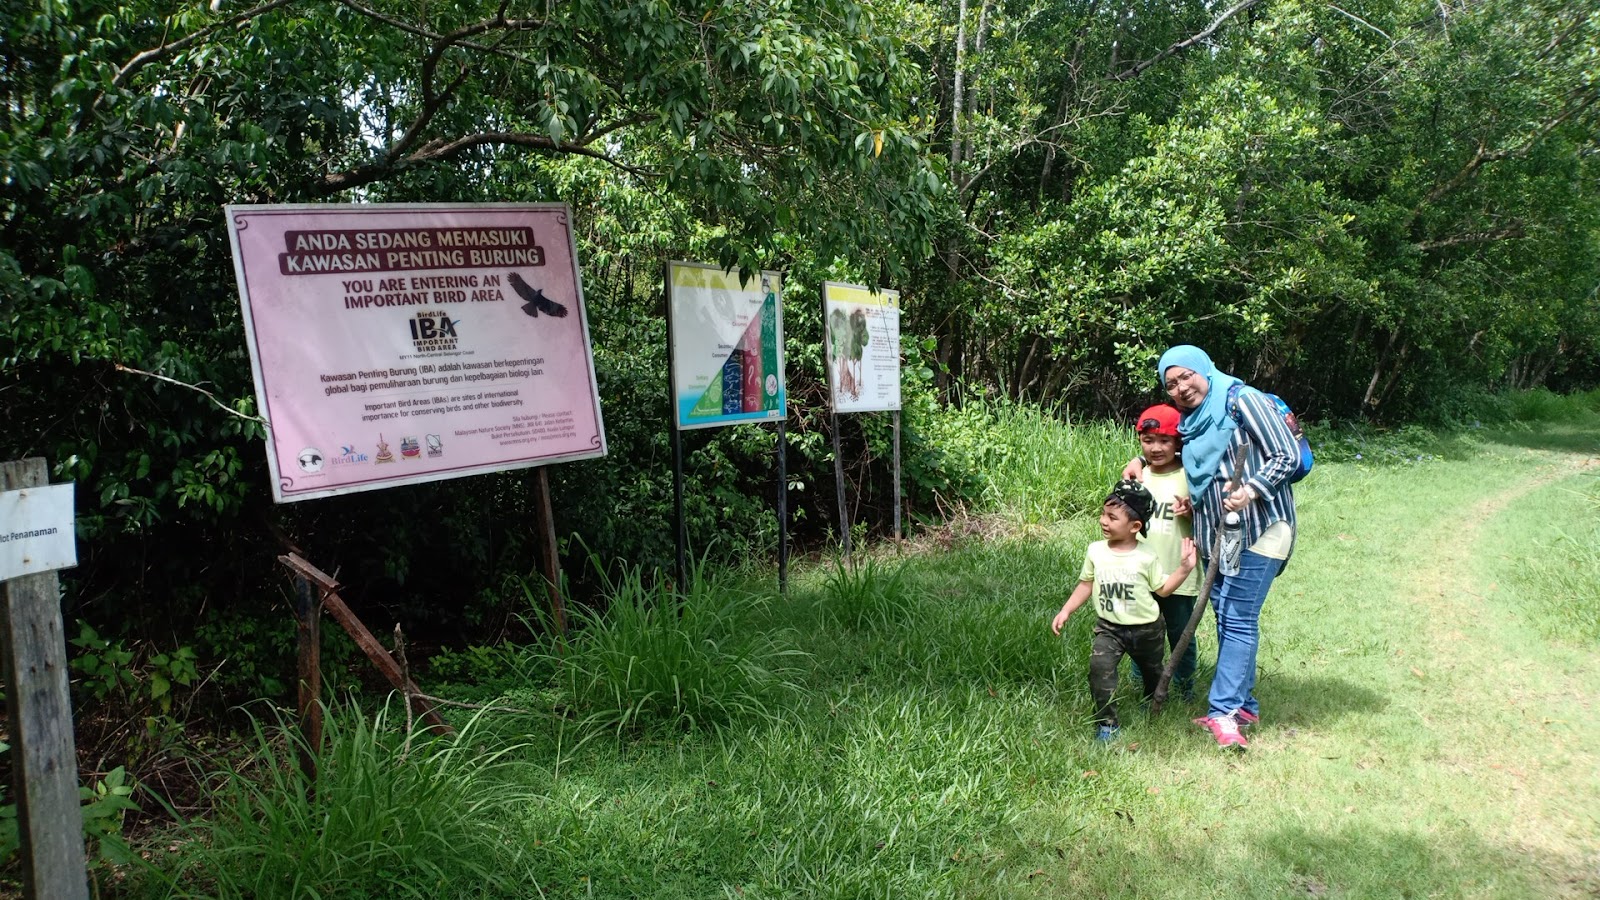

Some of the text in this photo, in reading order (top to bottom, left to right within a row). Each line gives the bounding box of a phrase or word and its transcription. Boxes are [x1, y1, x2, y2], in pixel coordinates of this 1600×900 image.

[295, 230, 528, 251] ANDA SEDANG MEMASUKI
[286, 248, 540, 273] KAWASAN PENTING BURUNG
[342, 274, 501, 294] YOU ARE ENTERING AN
[344, 288, 505, 309] IMPORTANT BIRD AREA
[416, 310, 447, 318] BirdLife
[409, 317, 458, 340] IBA
[413, 338, 459, 347] IMPORTANT
[320, 357, 545, 383] Kawasan Penting Burung (IBA) adalah kawasan berkepentingan
[325, 383, 349, 396] global
[350, 381, 368, 394] bagi
[369, 377, 421, 392] pemuliharaan
[422, 375, 449, 387] burung
[450, 373, 463, 383] dan
[464, 370, 508, 383] kepelbagaian
[508, 367, 531, 379] biologi
[364, 389, 519, 413] Important Bird Areas (IBAs) are sites of international
[361, 411, 399, 423] importance
[399, 408, 411, 418] for
[411, 405, 446, 418] conserving
[446, 404, 462, 413] birds
[462, 403, 474, 411] and
[474, 401, 490, 410] other
[331, 453, 369, 465] BirdLife
[1154, 502, 1174, 521] WE
[10, 527, 58, 541] Penanaman
[1099, 583, 1136, 601] AWE
